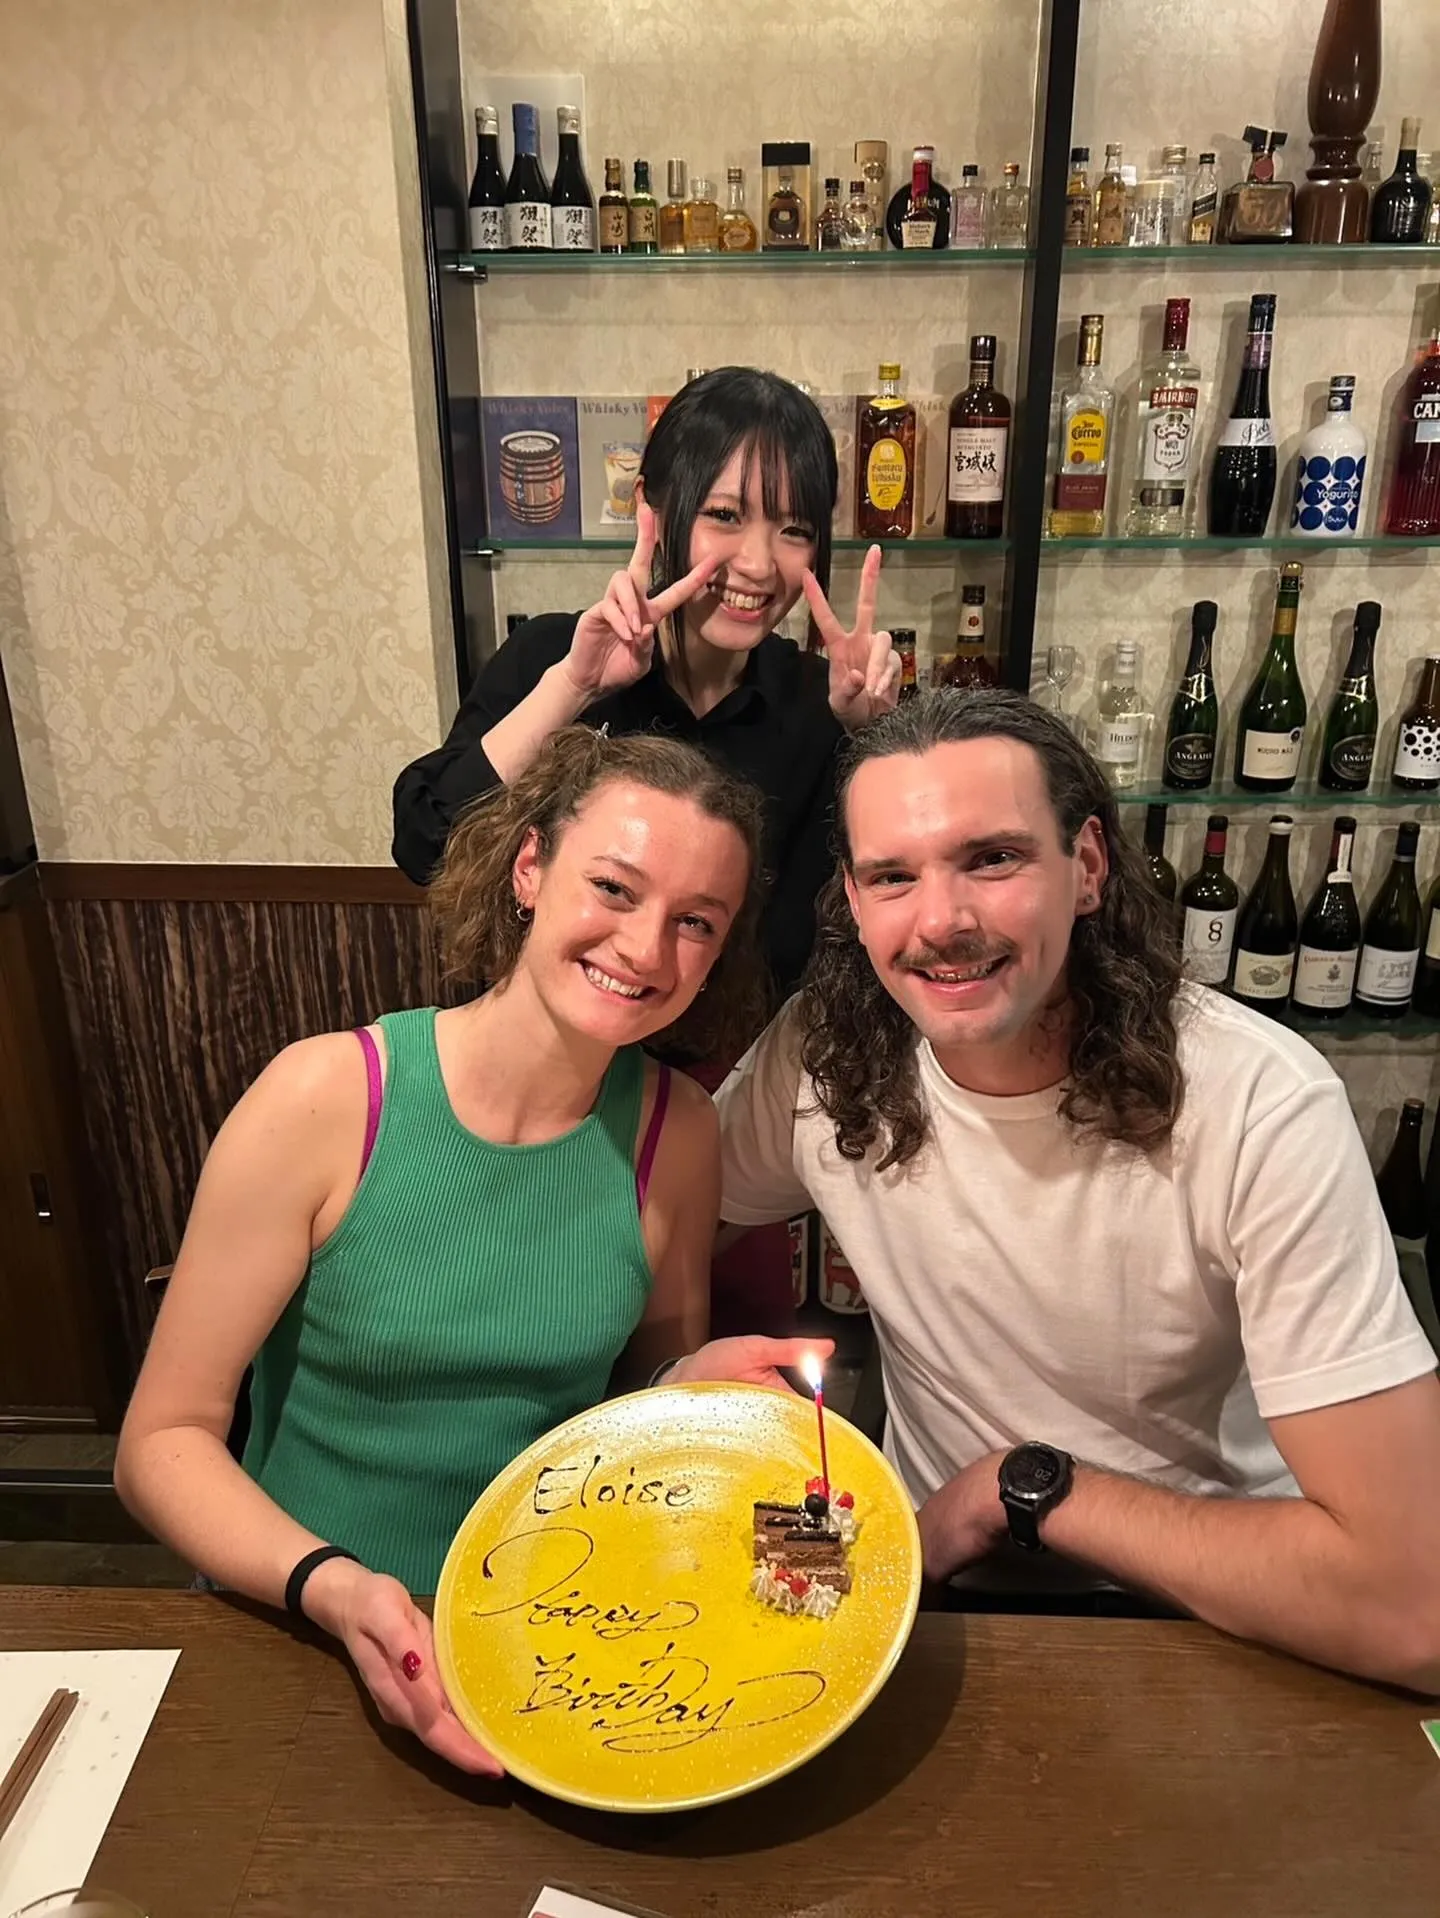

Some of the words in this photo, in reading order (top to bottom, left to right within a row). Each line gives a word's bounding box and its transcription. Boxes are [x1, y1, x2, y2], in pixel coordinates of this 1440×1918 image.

[582, 402, 630, 417] Whisky
[1207, 916, 1223, 946] 8
[533, 1455, 694, 1515] Eloise
[471, 1527, 699, 1641] Happy
